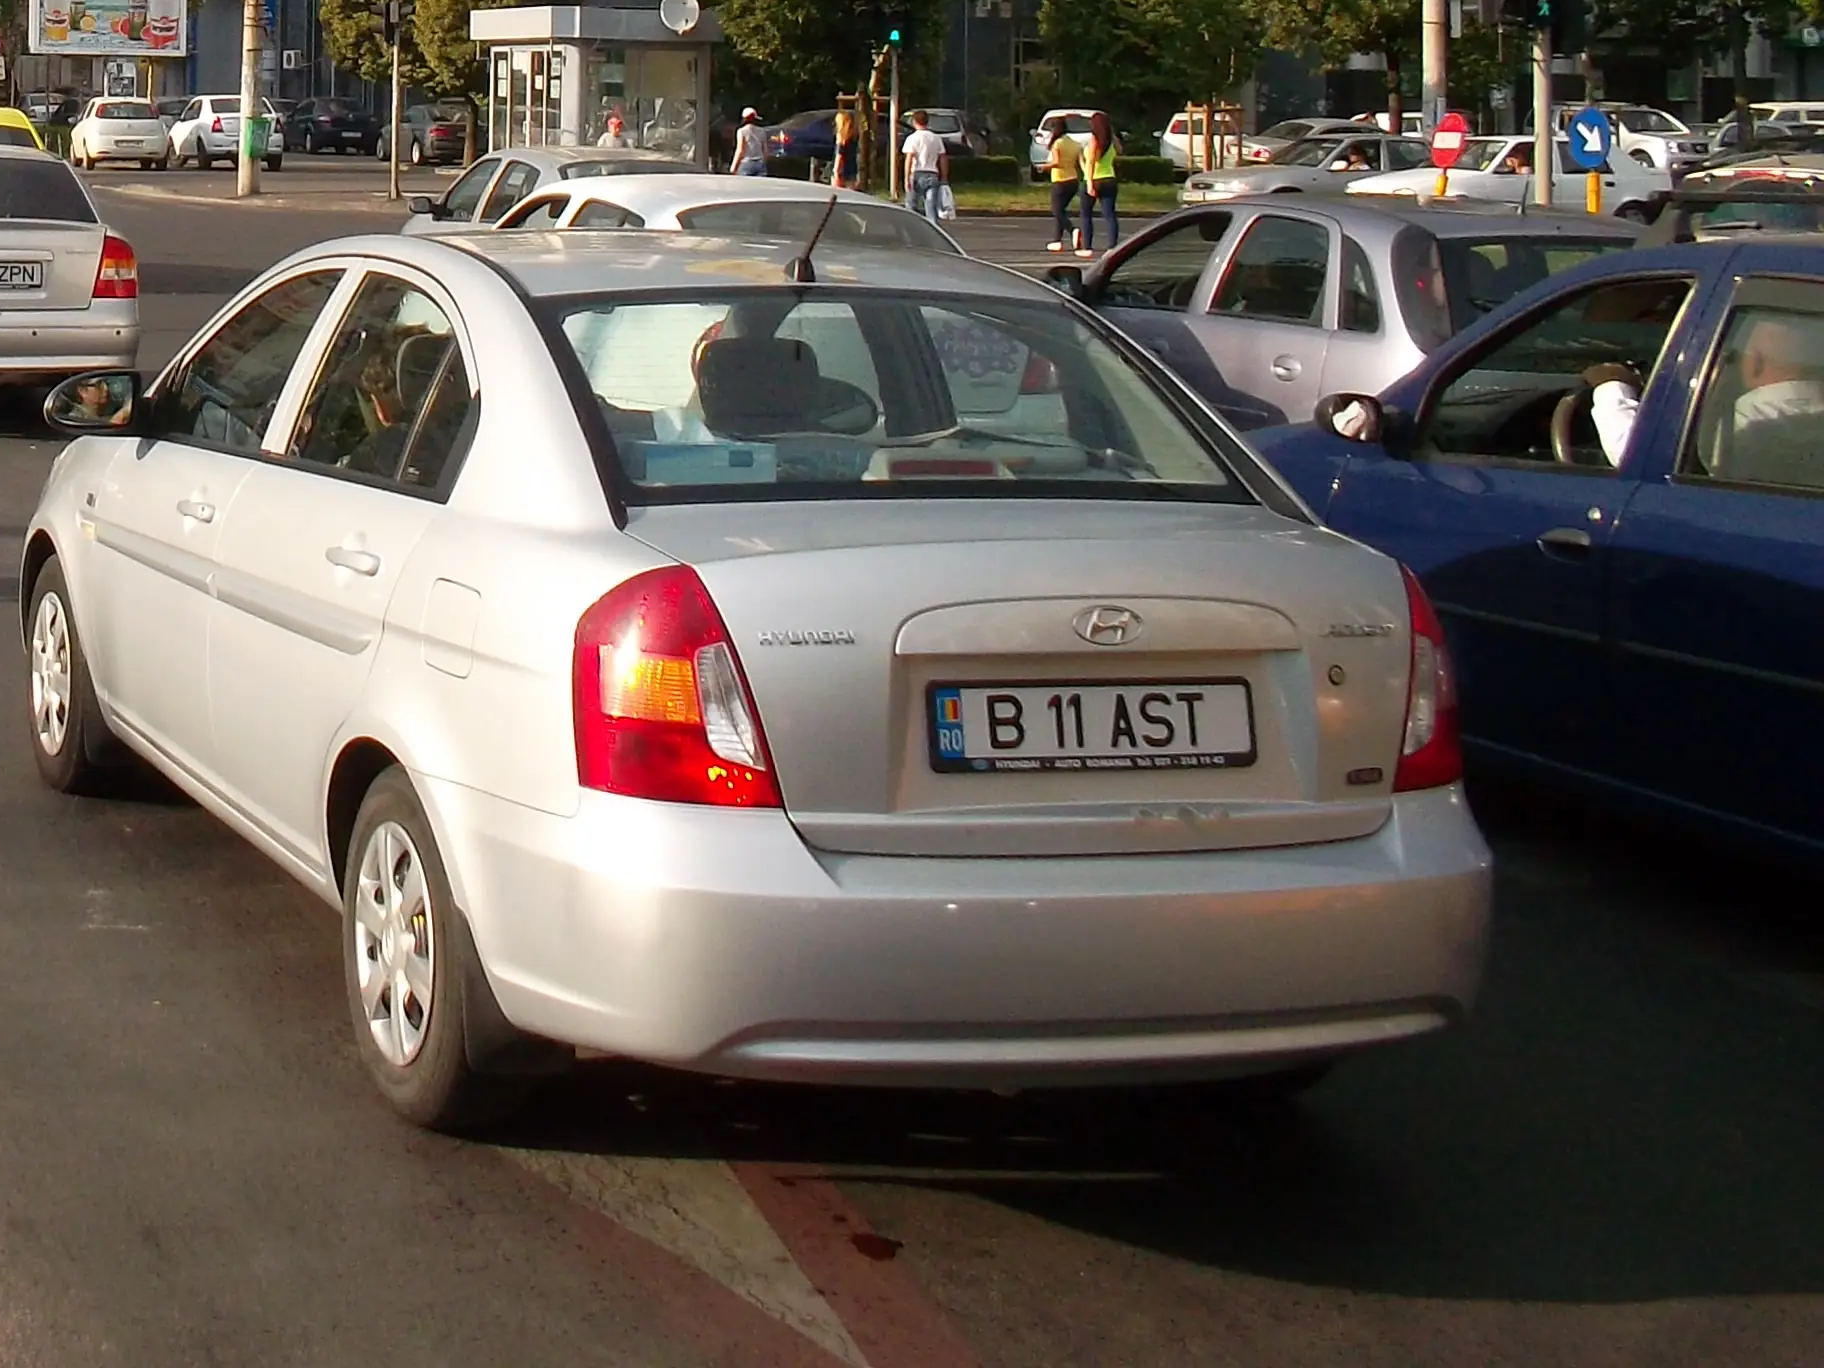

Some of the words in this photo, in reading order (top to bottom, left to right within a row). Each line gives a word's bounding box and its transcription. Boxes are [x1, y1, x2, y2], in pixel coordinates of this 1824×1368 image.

[758, 630, 856, 645] HYUNDAI
[986, 695, 1025, 749] B
[1046, 693, 1085, 749] 11
[1110, 692, 1205, 748] AST
[939, 728, 962, 752] RO
